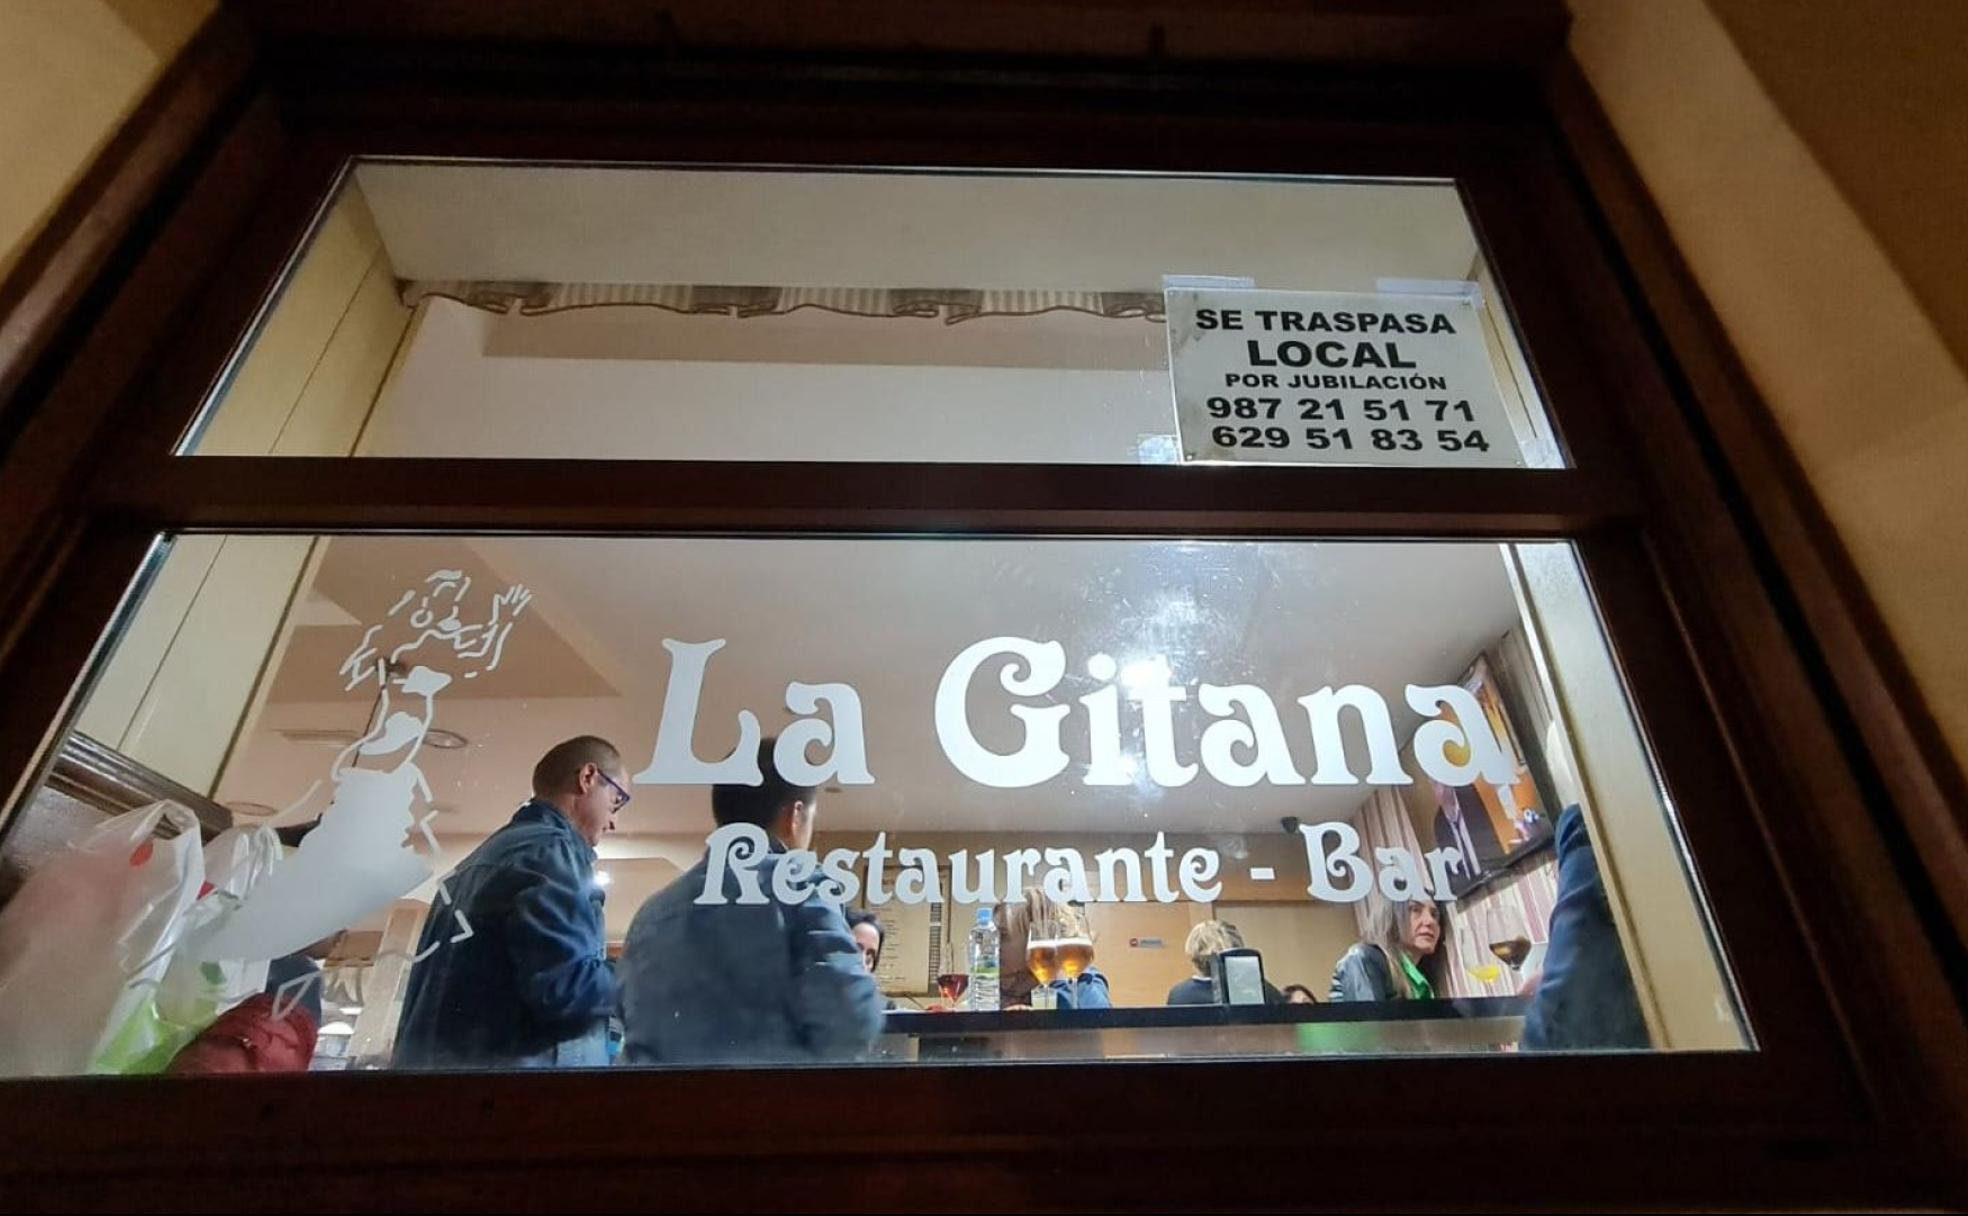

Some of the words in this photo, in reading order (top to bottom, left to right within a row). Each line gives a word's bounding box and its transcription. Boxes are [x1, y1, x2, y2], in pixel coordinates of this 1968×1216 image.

[1195, 309, 1243, 331] SE
[1255, 310, 1456, 334] TRASPASA
[1246, 340, 1416, 369] LOCAL
[1225, 373, 1279, 388] POR
[1288, 373, 1447, 390] JUBILACIÓN
[1207, 397, 1282, 419] 987
[1298, 398, 1345, 420] 21
[1364, 399, 1409, 421] 51
[1425, 400, 1475, 422] 71
[1212, 426, 1290, 449] 629
[1305, 428, 1353, 450] 51
[1371, 429, 1423, 451] 83
[1437, 430, 1489, 452] 54
[632, 638, 875, 787] La
[935, 636, 1519, 788] Gitana
[694, 822, 1222, 904] Restaurante
[1299, 822, 1462, 902] Bar
